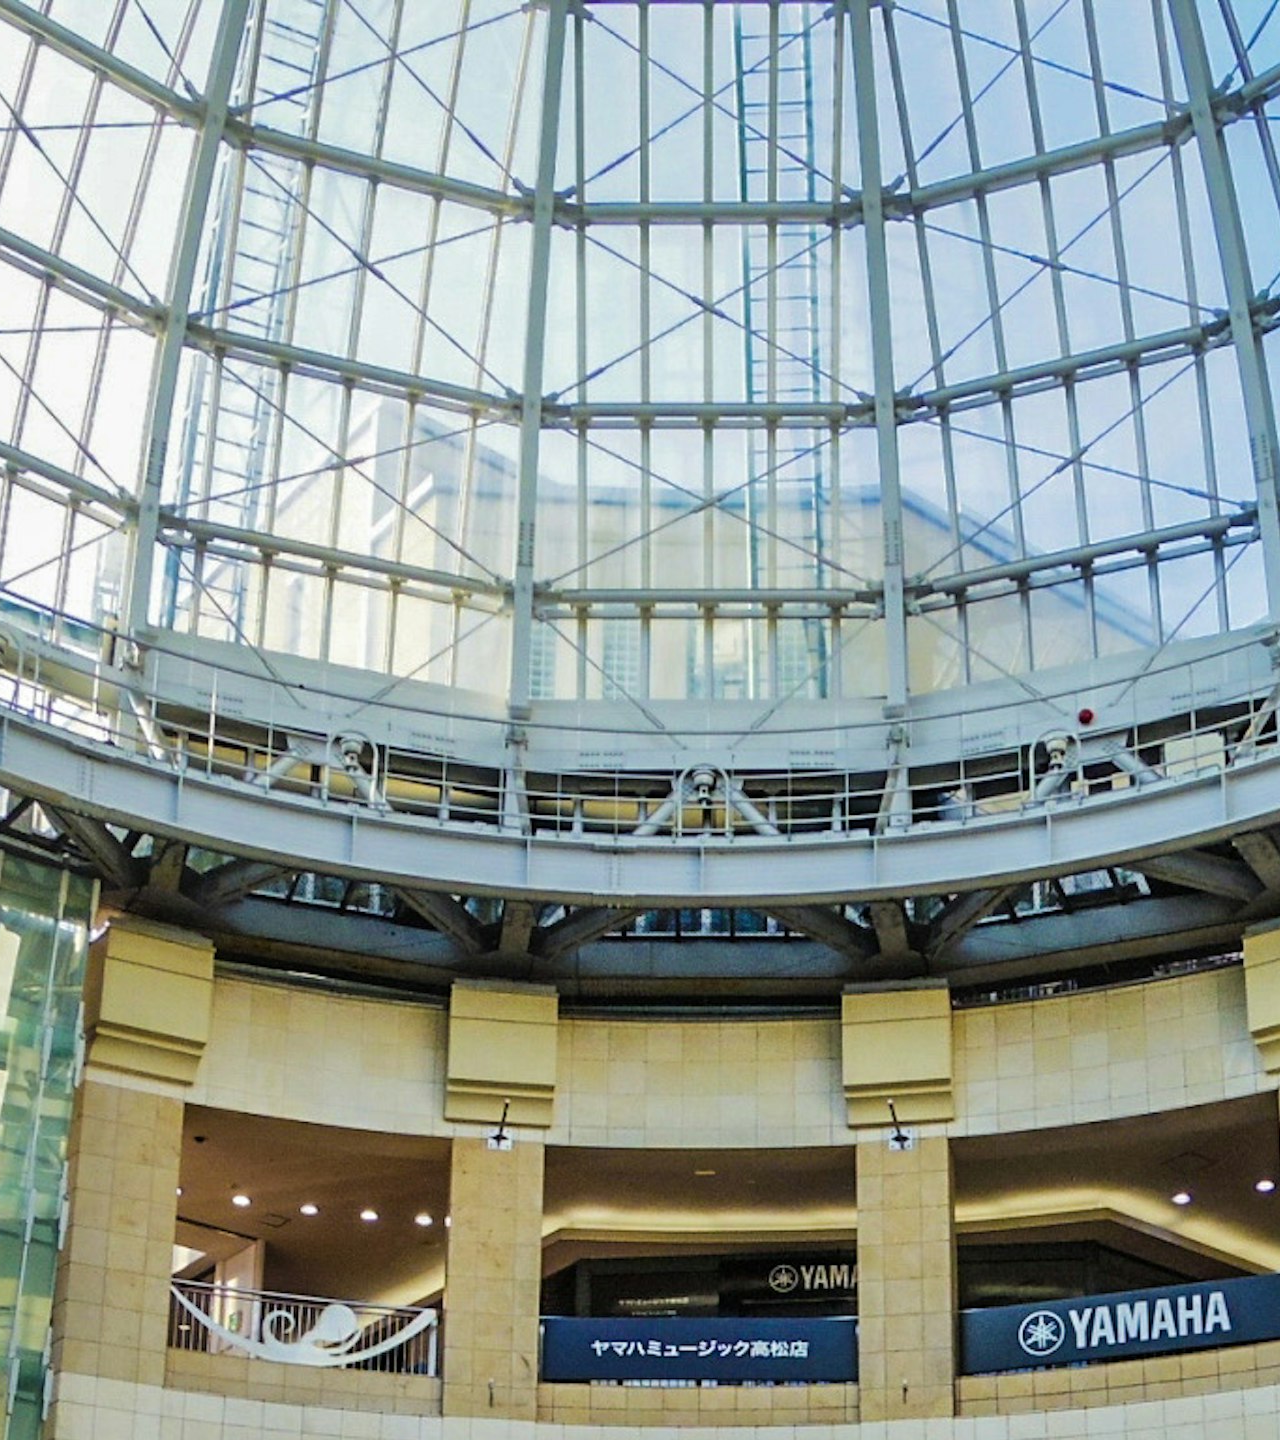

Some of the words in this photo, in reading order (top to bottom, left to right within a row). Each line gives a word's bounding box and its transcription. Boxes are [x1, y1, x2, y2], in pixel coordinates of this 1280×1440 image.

[1069, 1291, 1232, 1349] YAMAHA
[591, 1339, 810, 1358] ヤマハミュージック高松店
